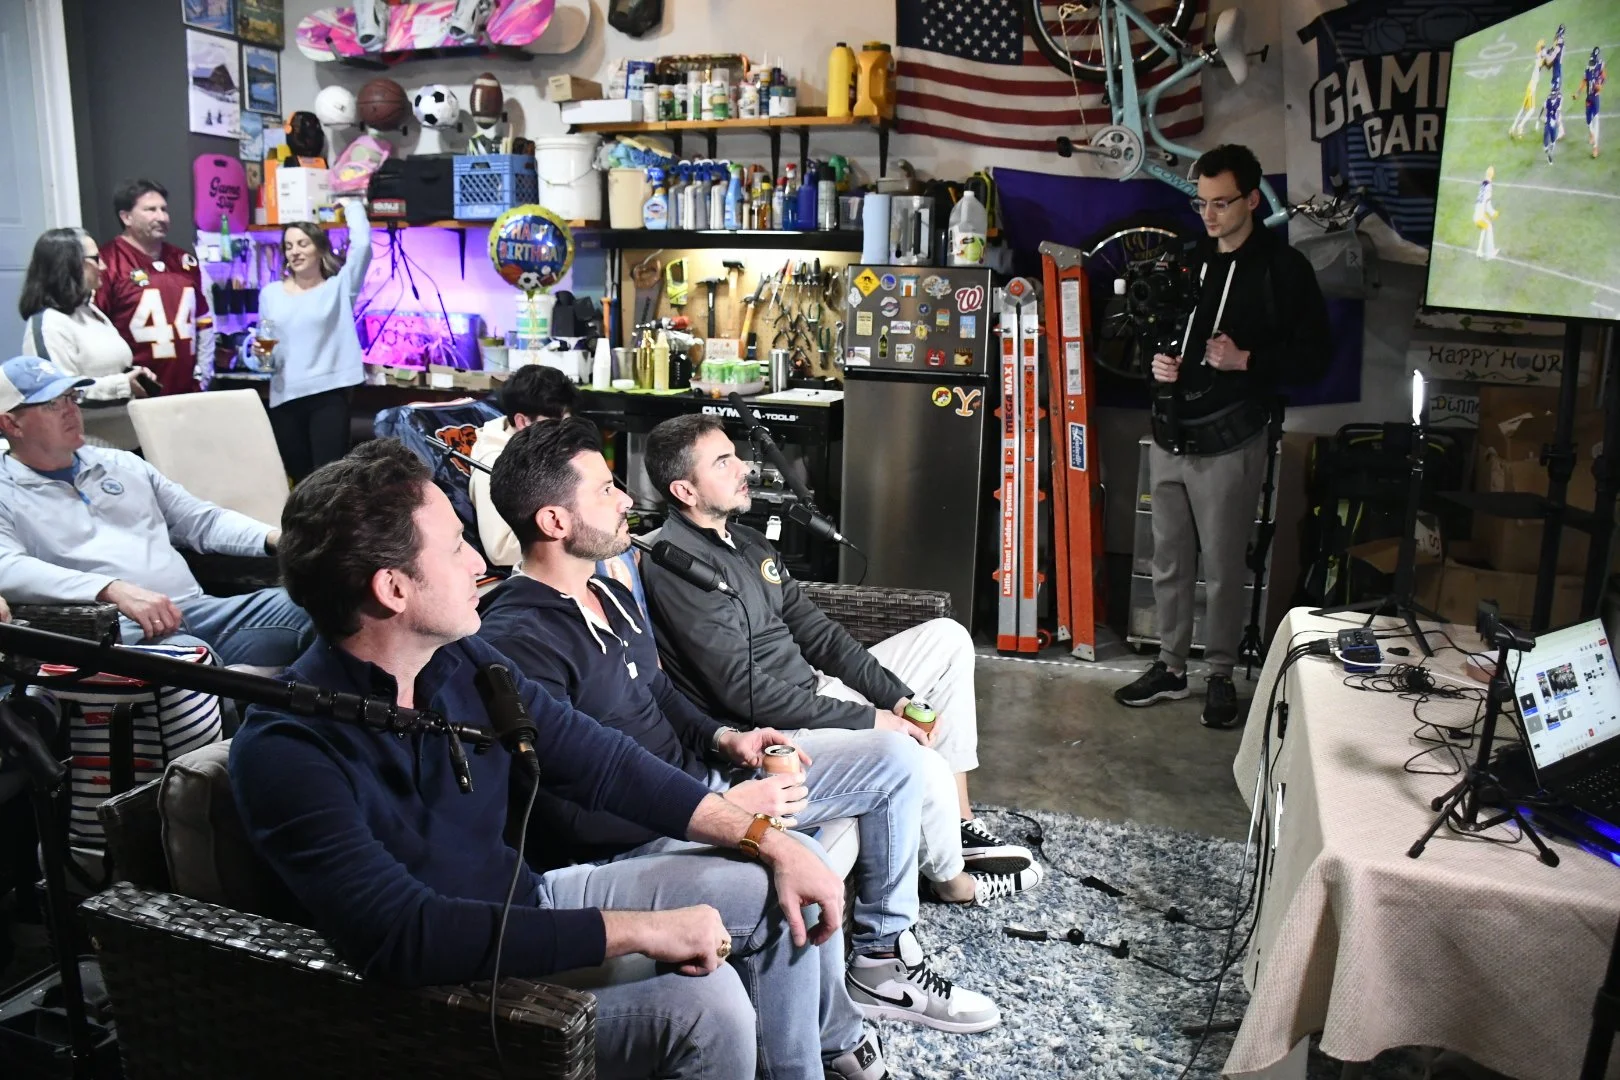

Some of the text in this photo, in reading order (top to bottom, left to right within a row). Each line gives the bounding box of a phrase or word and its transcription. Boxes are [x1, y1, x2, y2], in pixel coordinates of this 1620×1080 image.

[208, 176, 241, 198] Game
[216, 195, 236, 214] Day
[499, 240, 566, 262] BIRTHDAY
[129, 287, 197, 359] 44
[702, 406, 762, 420] OLYMA
[1003, 482, 1013, 595] Little Giant Ladder Systems
